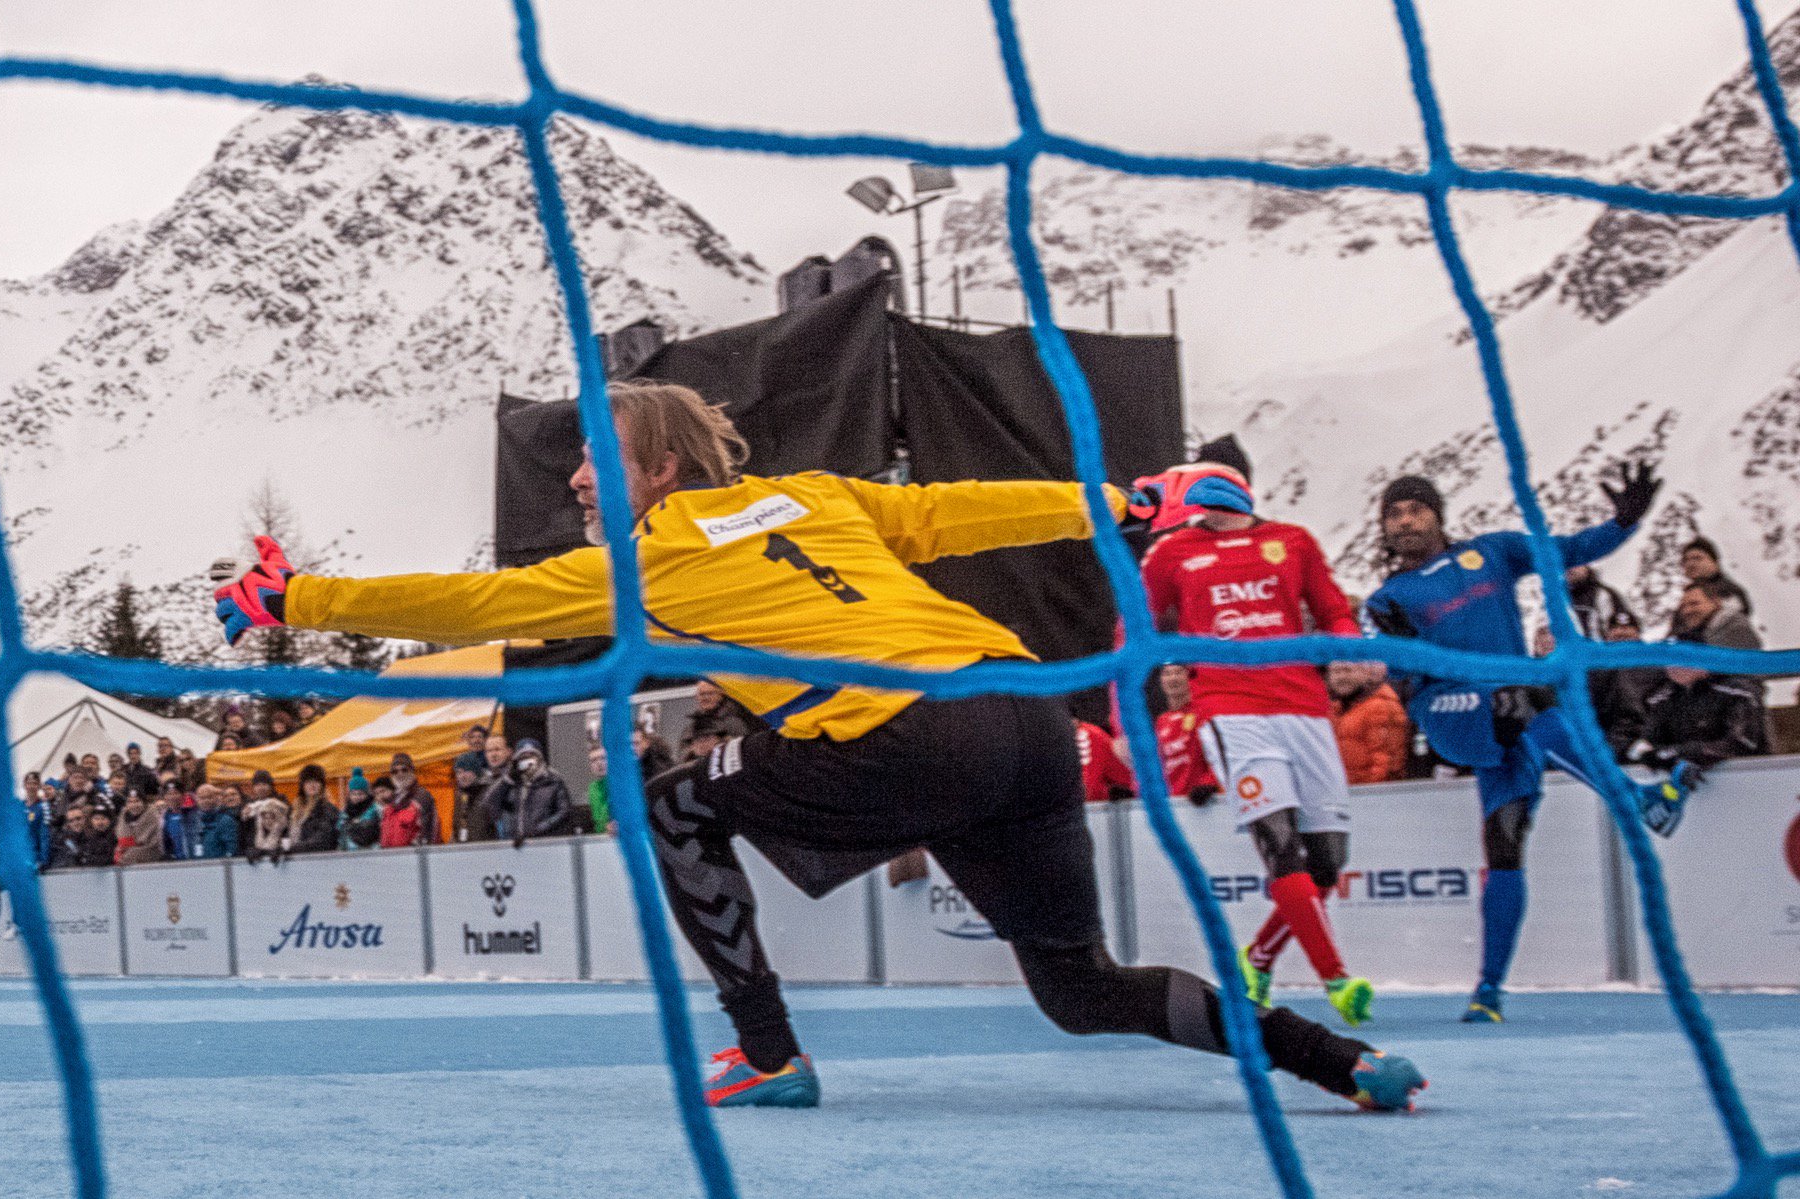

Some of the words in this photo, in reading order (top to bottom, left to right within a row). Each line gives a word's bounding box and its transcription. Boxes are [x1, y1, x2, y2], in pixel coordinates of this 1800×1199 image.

[762, 533, 868, 603] 1
[269, 903, 384, 954] Arosa
[463, 921, 541, 955] hummel
